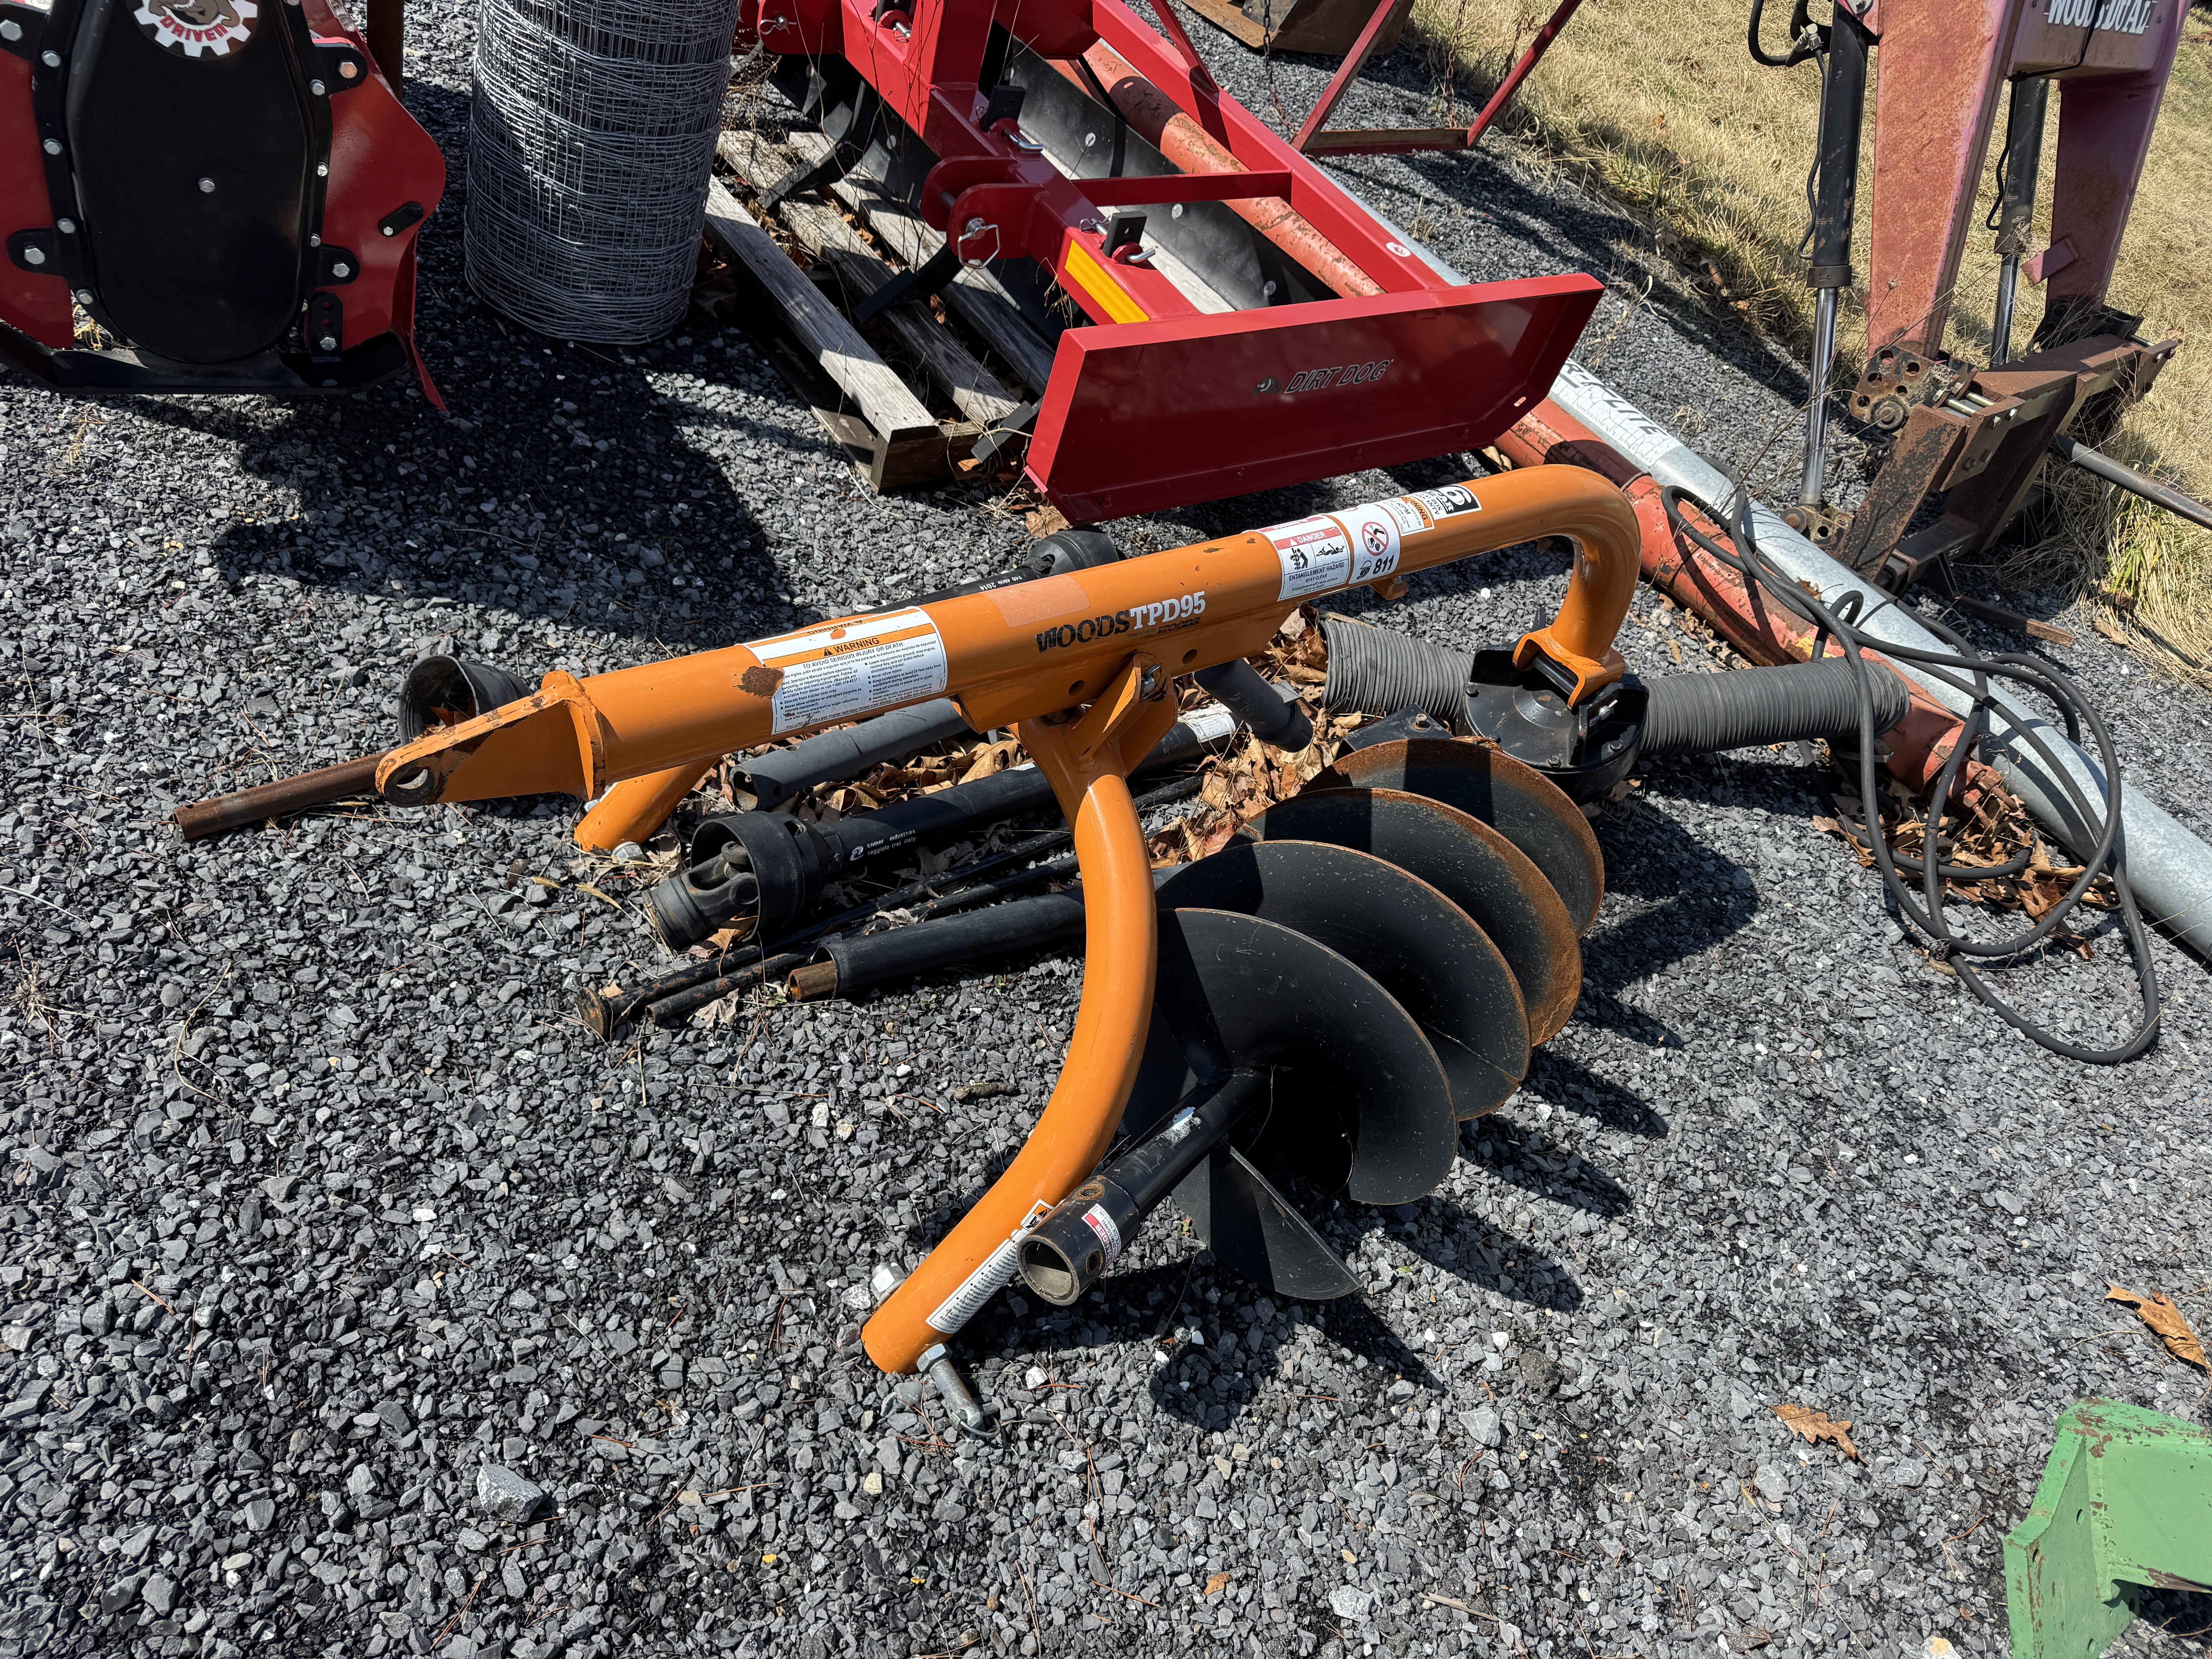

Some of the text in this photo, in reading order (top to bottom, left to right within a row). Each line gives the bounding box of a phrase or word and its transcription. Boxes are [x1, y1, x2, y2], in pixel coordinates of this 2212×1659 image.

[2101, 0, 2150, 34] DUAL
[160, 15, 228, 42] DRIVEN
[1284, 360, 1391, 393] DIRT DOG
[1409, 497, 1428, 520] RNING
[1297, 532, 1326, 543] DANGER
[1289, 562, 1344, 580] ENTANGLEMENT HAZARD
[1373, 555, 1394, 575] 811
[1036, 591, 1205, 653] WOODS TPD95
[830, 653, 855, 663] SERIOUS
[855, 648, 875, 657] INJURY
[834, 637, 879, 653] WARNING
[890, 830, 915, 841] industries
[868, 845, 890, 855] reggiolo
[1095, 1223, 1112, 1259] DANGER
[1102, 1220, 1115, 1243] MISSING
